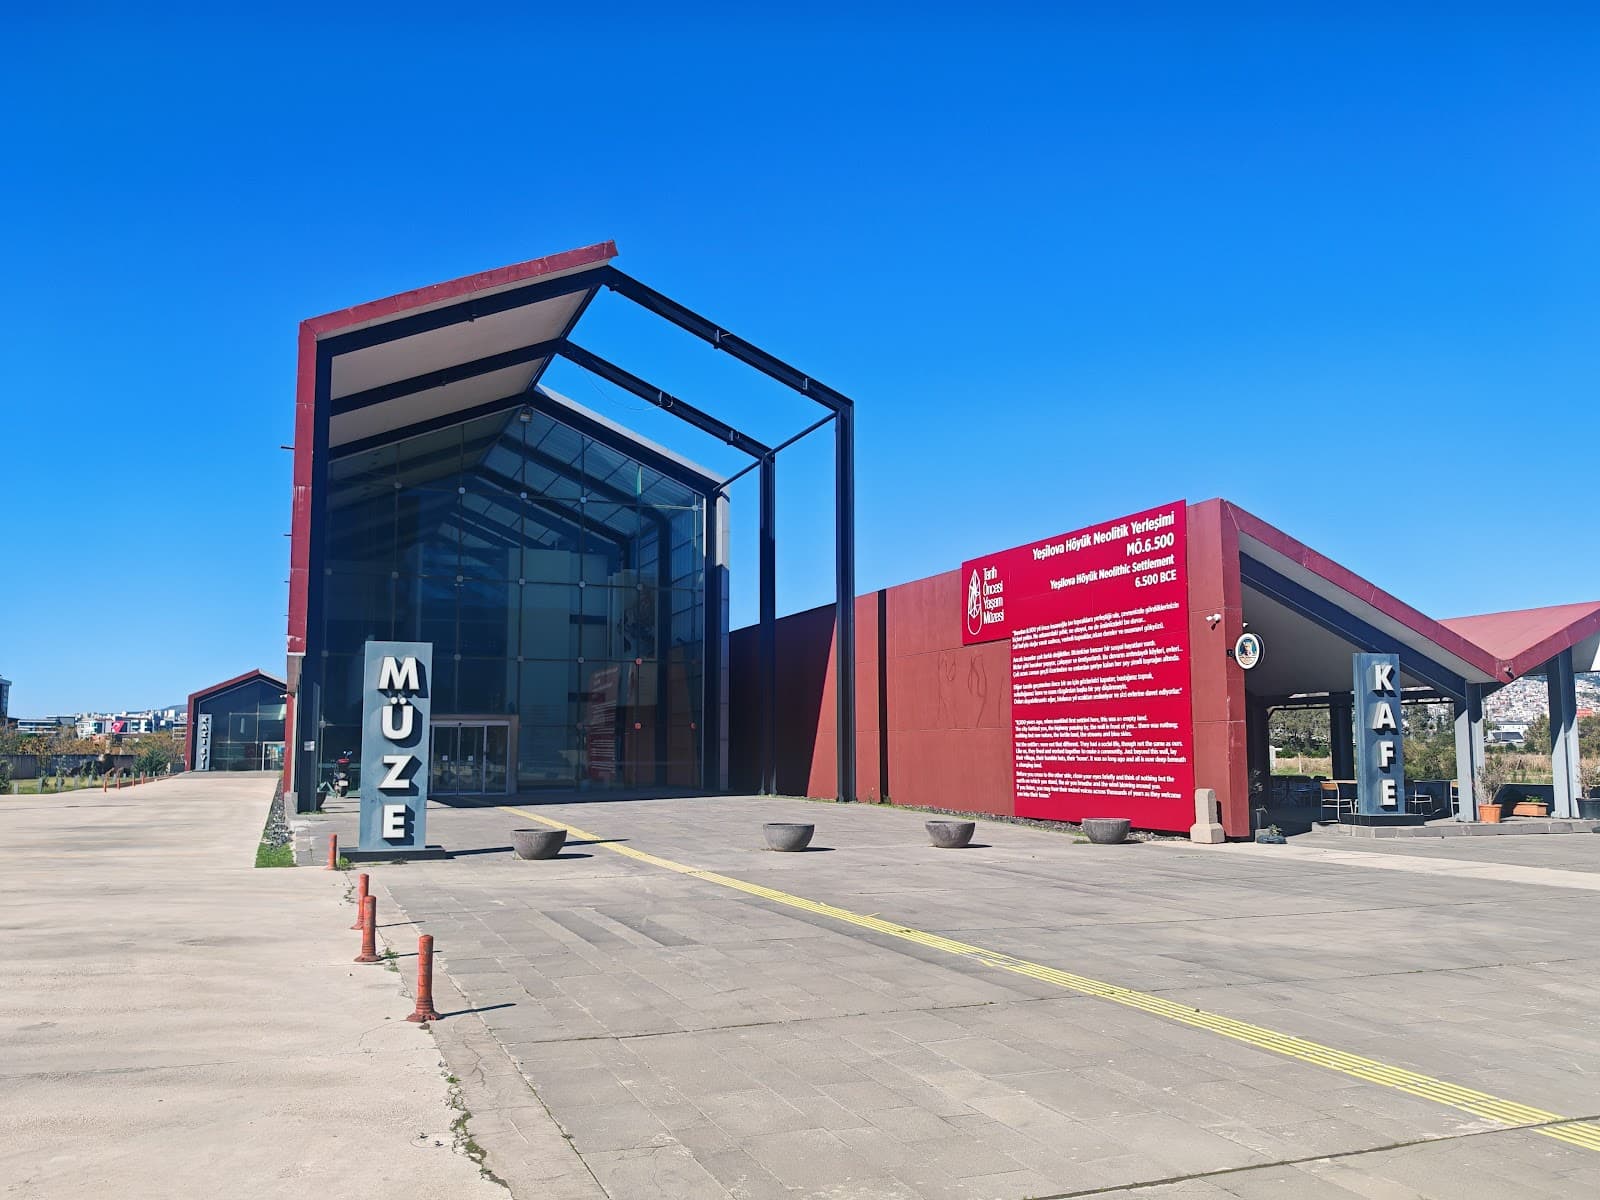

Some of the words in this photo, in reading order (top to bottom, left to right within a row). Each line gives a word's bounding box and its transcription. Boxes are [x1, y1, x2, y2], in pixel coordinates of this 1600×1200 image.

[1032, 544, 1065, 561] Yeşilova
[1065, 533, 1092, 553] Höyük
[1093, 521, 1129, 545] Neolitik
[1130, 510, 1175, 536] Yerleşimi
[1126, 532, 1175, 557] MÖ.6.500
[1049, 576, 1076, 591] Yeşilova
[1076, 569, 1098, 585] Höyük
[1098, 562, 1131, 580] Neolithic
[1131, 553, 1175, 573] Settlement
[1134, 574, 1159, 589] 6.500
[1159, 568, 1177, 584] BCE
[983, 579, 1003, 596] Öncesi
[983, 595, 1004, 611] Yaşam
[984, 609, 1005, 625] Müzesi
[378, 656, 420, 839] MÜZE
[1372, 664, 1397, 806] KAFE
